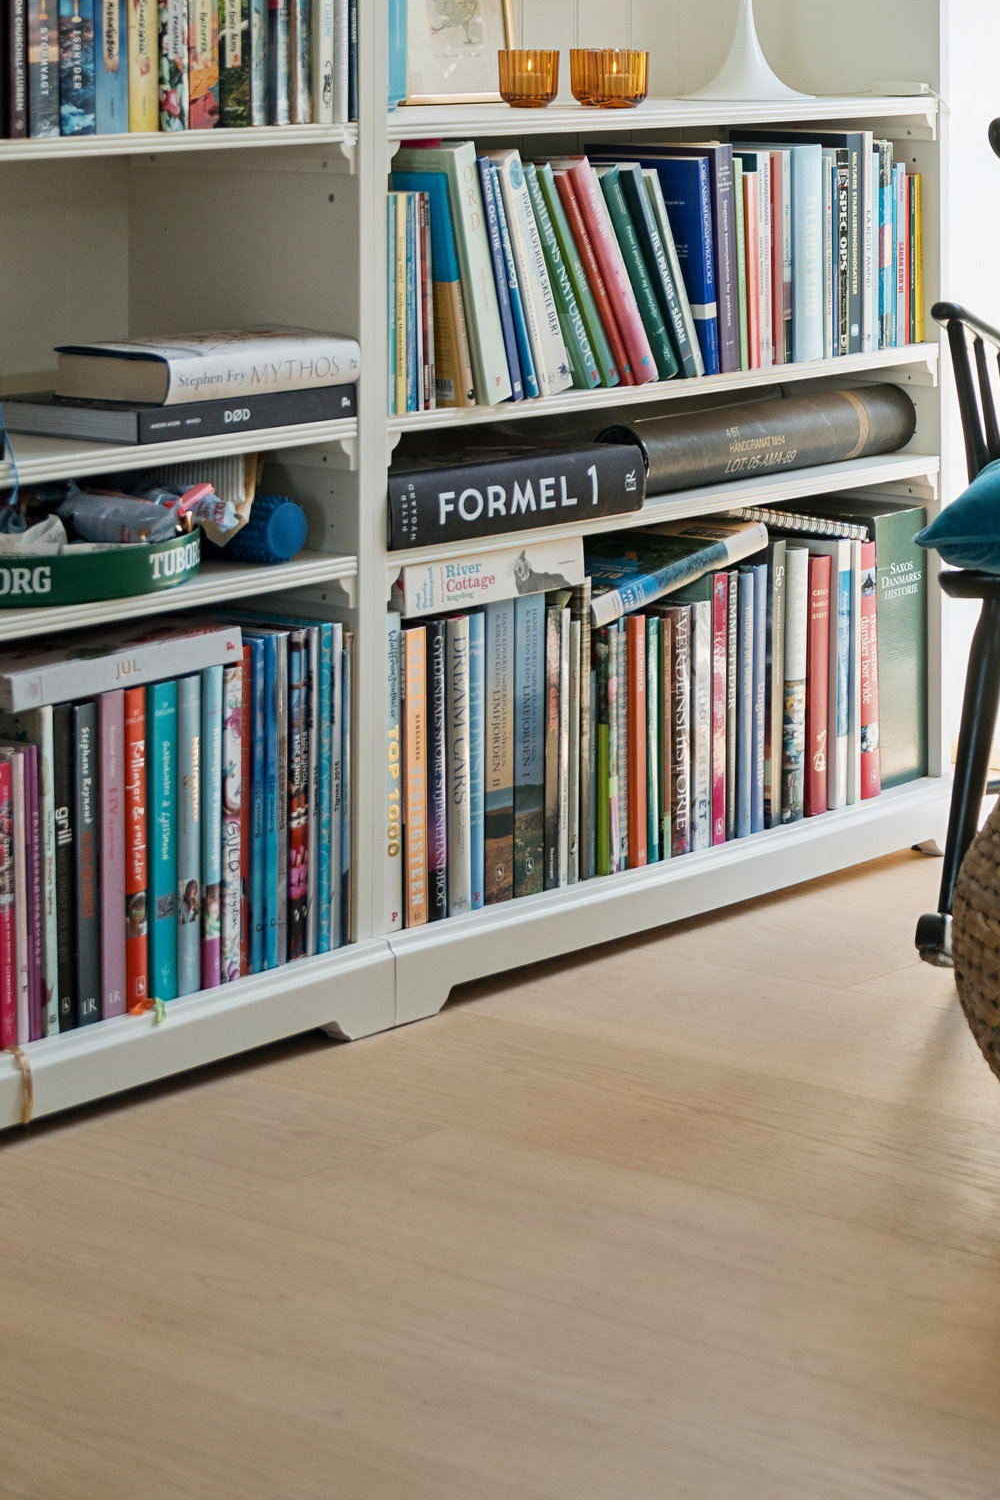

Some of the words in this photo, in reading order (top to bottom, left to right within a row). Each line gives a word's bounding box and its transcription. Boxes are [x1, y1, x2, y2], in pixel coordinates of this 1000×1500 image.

[15, 17, 24, 111] CHURCHILL-KLUBBEN
[73, 30, 82, 89] ISBRYDER
[482, 168, 493, 202] KNOB
[522, 192, 535, 218] HVAD
[488, 204, 497, 223] OG
[700, 164, 712, 284] ORGANISATIONSPSYKOLOGI
[839, 190, 848, 232] SPEC
[491, 225, 501, 251] STIK
[528, 227, 547, 278] ALVERDEN
[839, 236, 848, 271] OPS
[527, 172, 563, 263] FAMILIENS
[557, 267, 595, 367] NATURBOG
[573, 261, 589, 292] æbler
[540, 280, 553, 310] SKETE
[656, 256, 675, 300] PRAKSIS
[672, 307, 686, 343] SÅDAN
[546, 313, 560, 337] DER?
[177, 372, 224, 390] Stephen
[227, 368, 247, 385] Fry
[250, 355, 340, 385] MYTHOS
[224, 408, 250, 423] DØD
[400, 495, 409, 533] PETER
[408, 484, 418, 541] NYGAARD
[438, 476, 578, 525] FORMEL
[586, 464, 599, 505] 1
[149, 538, 200, 580] TUBOR
[445, 562, 482, 578] River
[774, 565, 785, 592] Se,
[881, 570, 922, 589] DANMARKS
[890, 560, 914, 575] SAXOS
[446, 574, 496, 593] Cottage
[884, 583, 919, 600] HISTORIE
[728, 582, 737, 709] GEMMESTEDER
[860, 616, 870, 657] dansker
[114, 659, 141, 680] JUL
[452, 636, 466, 735] DREAM
[861, 659, 871, 678] bør
[755, 682, 766, 727] Unger
[862, 681, 872, 704] vide
[492, 690, 501, 772] LIMFJORDEN
[522, 685, 531, 766] LIMFJORDEN
[675, 616, 690, 830] VERDENSHISTORIE
[80, 727, 92, 775] Stéphane
[387, 724, 400, 779] TOP
[453, 738, 467, 805] CARS
[82, 777, 93, 824] Reynaud
[55, 806, 73, 846] grill
[388, 787, 401, 858] 1000
[410, 764, 424, 906] SPRINGSTEEN
[227, 821, 240, 872] GULD
